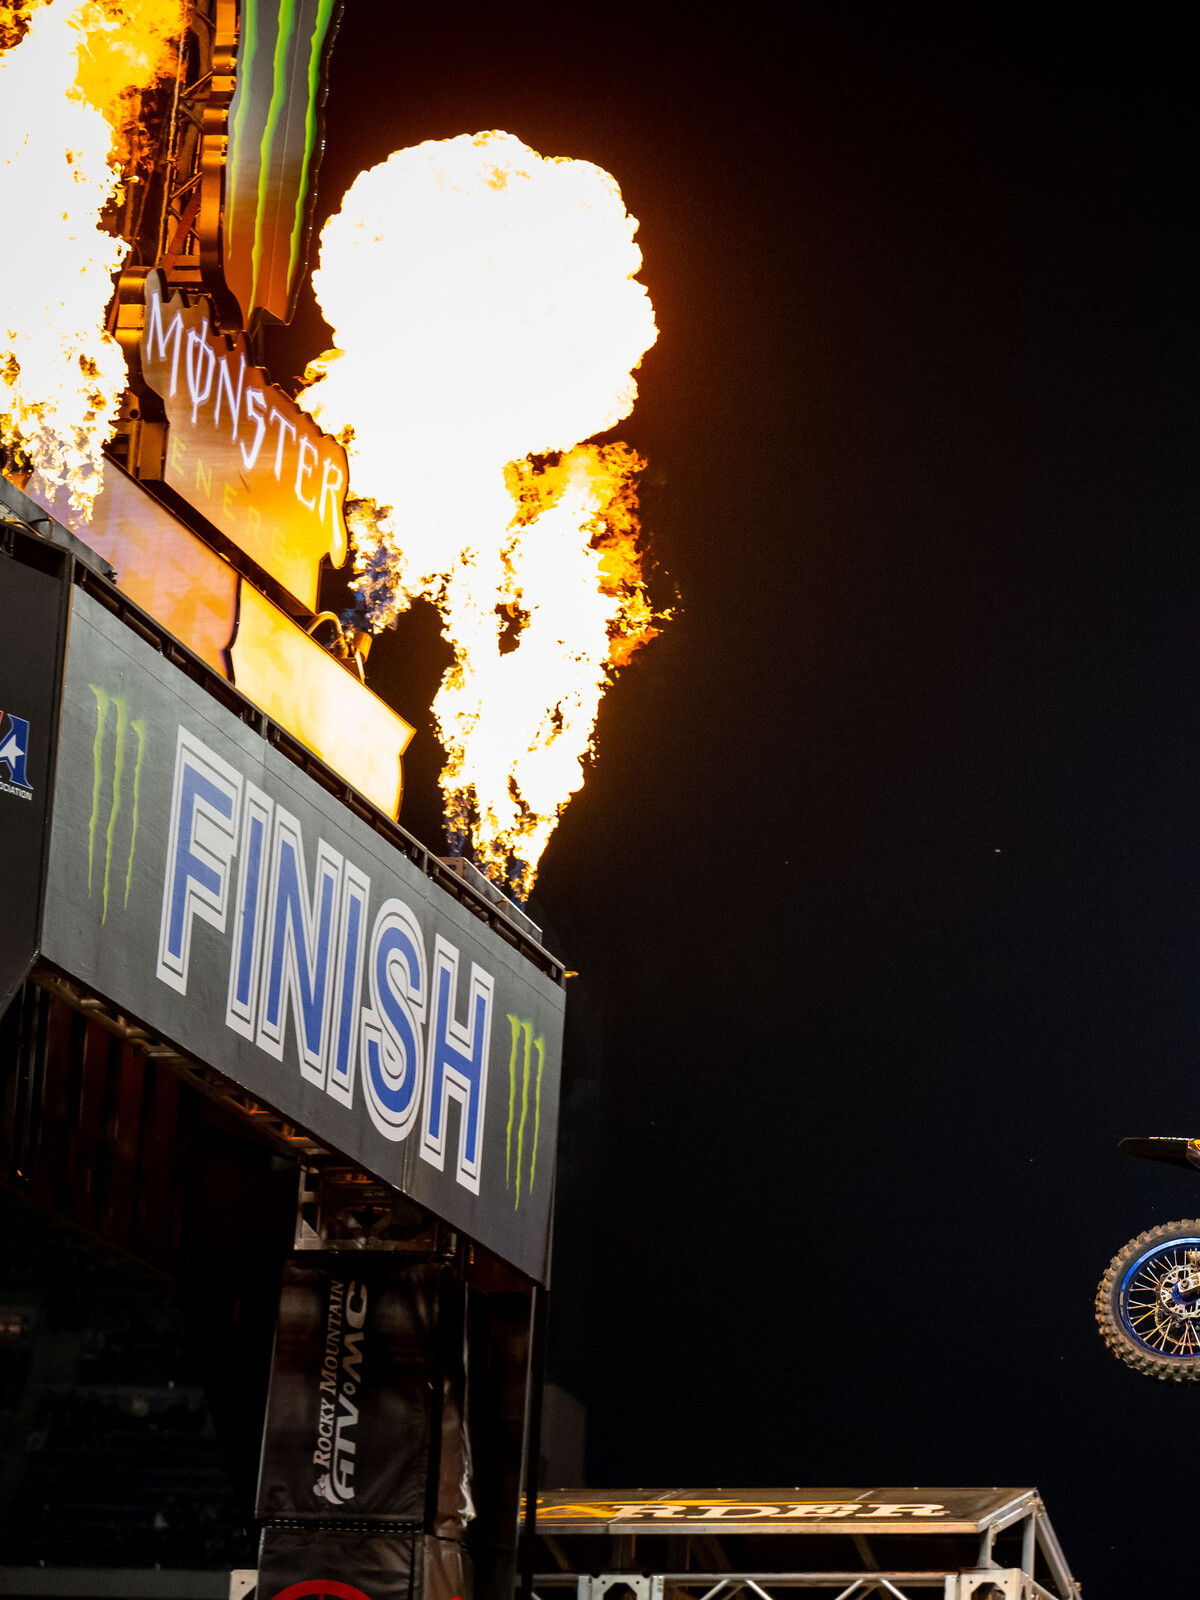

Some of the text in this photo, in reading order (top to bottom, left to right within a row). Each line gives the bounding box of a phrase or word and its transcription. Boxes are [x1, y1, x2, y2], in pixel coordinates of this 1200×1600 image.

[170, 435, 303, 573] ENERG
[156, 725, 495, 1196] FINISH
[313, 1280, 345, 1470] ROCKY MOUNTAIN
